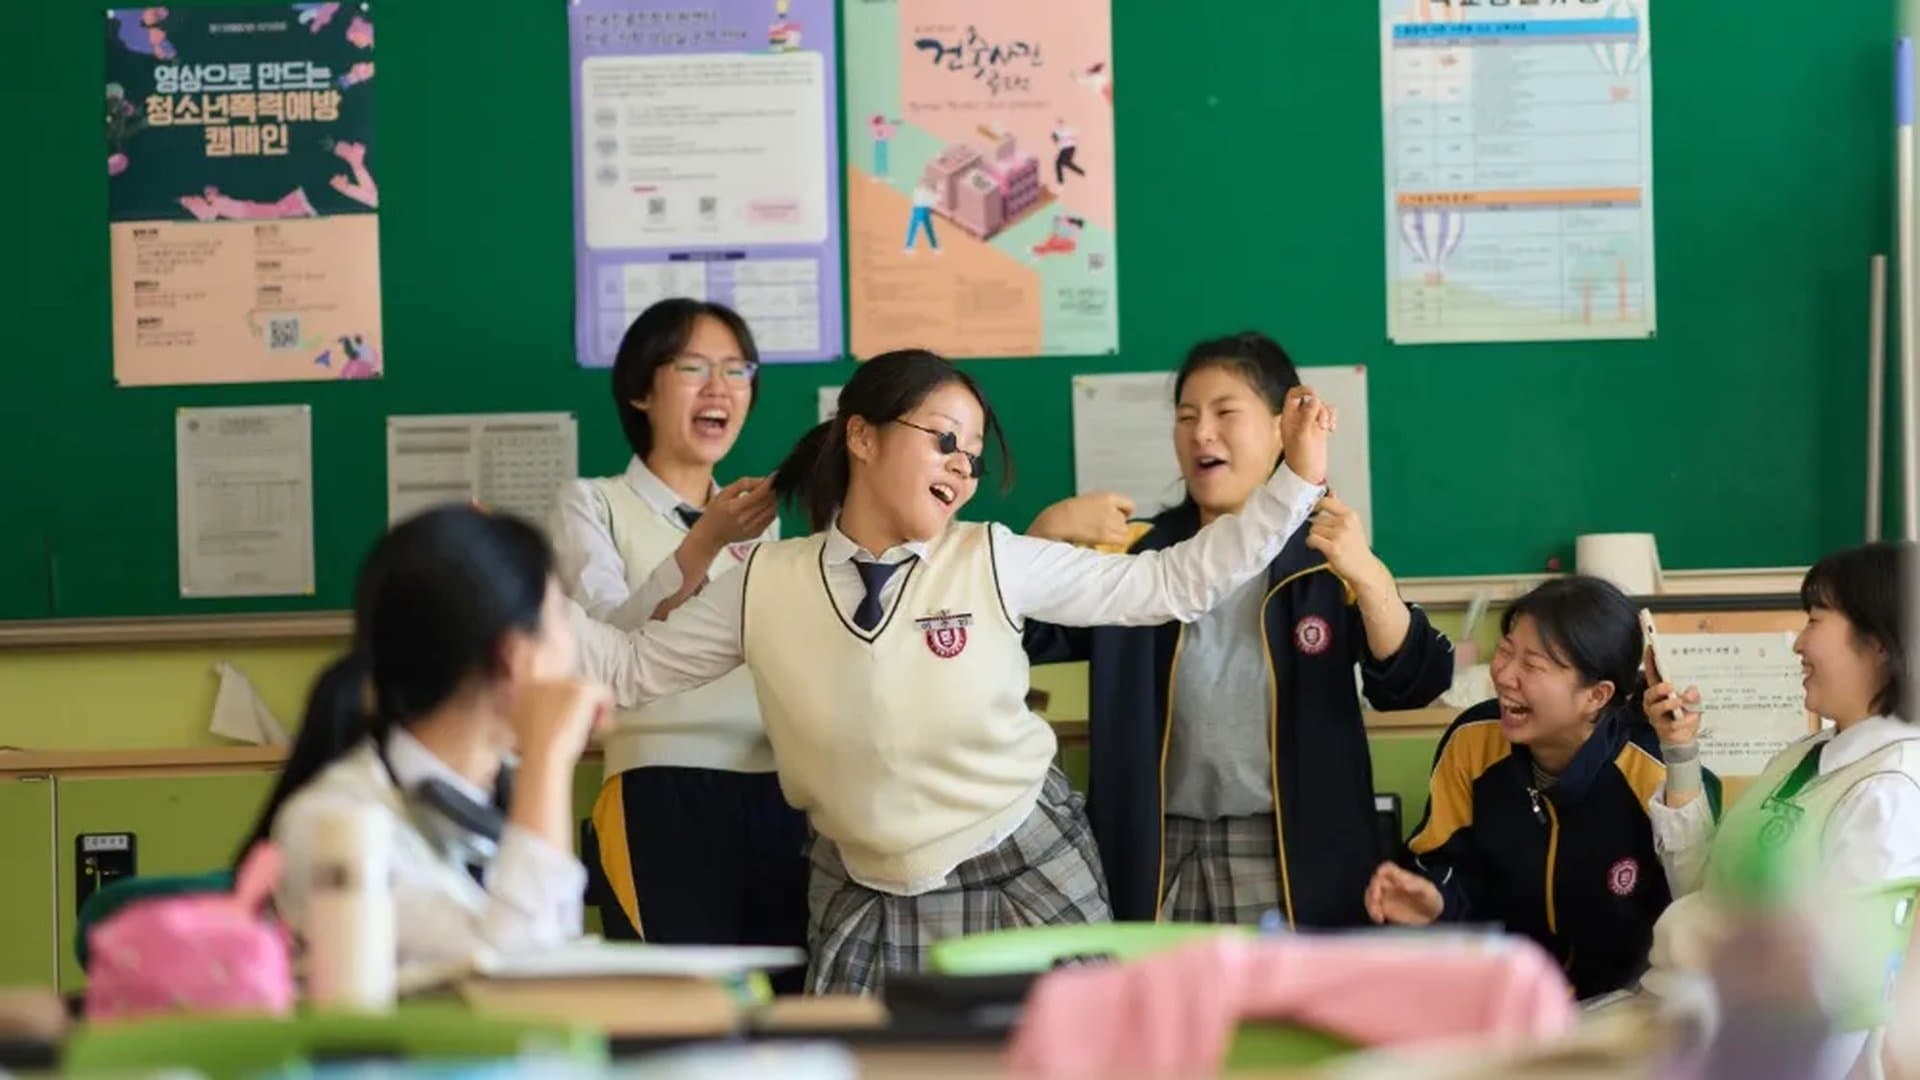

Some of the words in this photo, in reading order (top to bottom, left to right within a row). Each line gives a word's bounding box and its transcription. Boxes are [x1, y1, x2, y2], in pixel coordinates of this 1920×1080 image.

[914, 25, 1044, 79] 건축사진
[154, 62, 252, 92] 영상으로
[258, 60, 331, 90] 만드는
[146, 91, 341, 125] 청소년폭력예방
[206, 125, 288, 156] 캠페인
